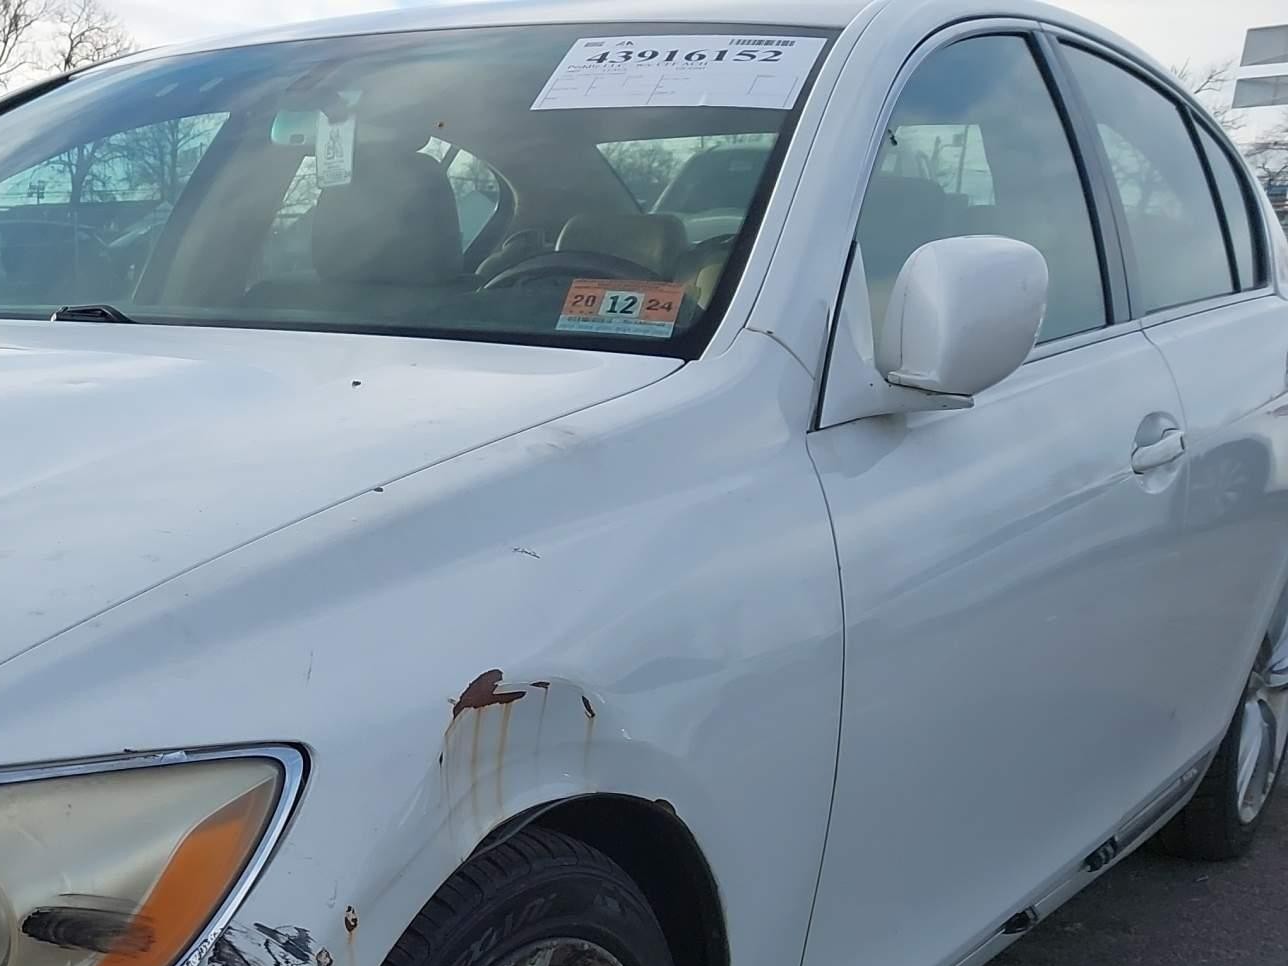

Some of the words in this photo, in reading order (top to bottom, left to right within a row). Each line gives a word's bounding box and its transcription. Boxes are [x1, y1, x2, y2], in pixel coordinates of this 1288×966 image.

[585, 49, 783, 64] 43916152
[572, 294, 596, 308] 20
[606, 295, 639, 315] 12
[646, 299, 673, 312] 24
